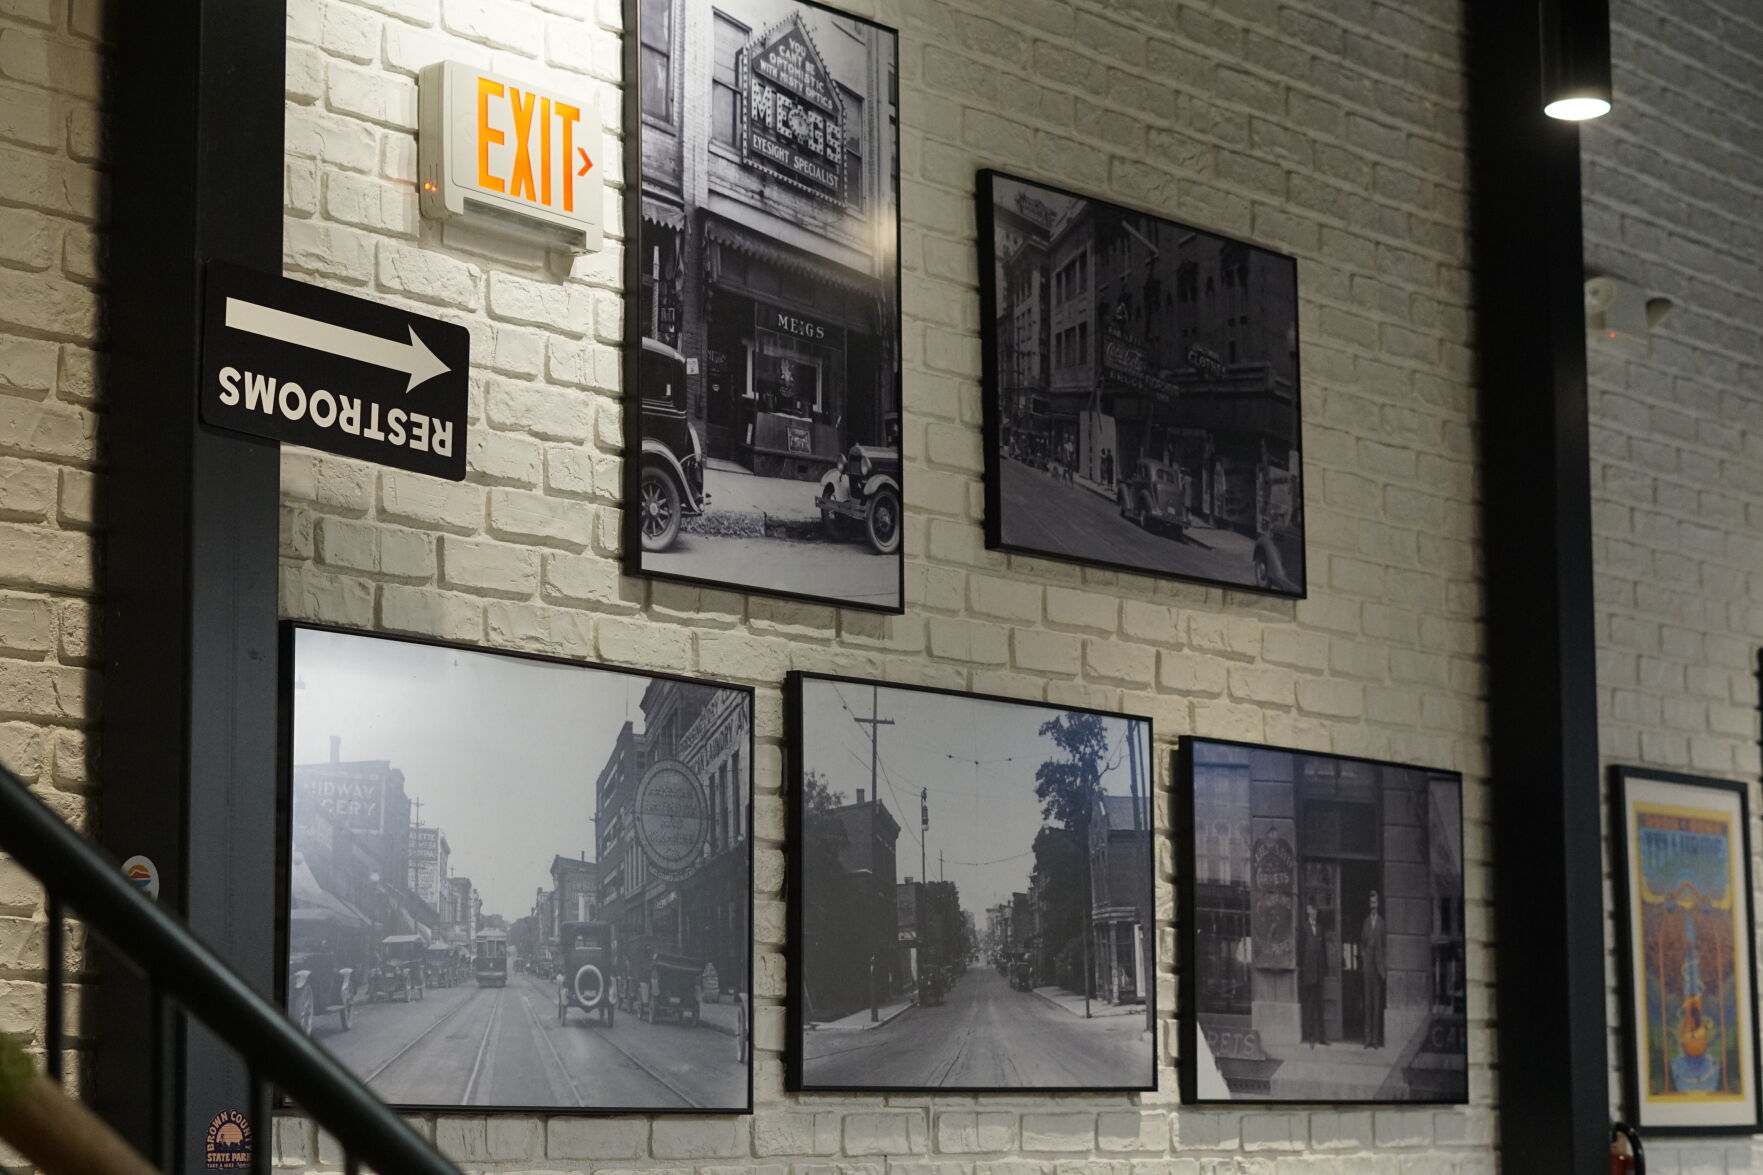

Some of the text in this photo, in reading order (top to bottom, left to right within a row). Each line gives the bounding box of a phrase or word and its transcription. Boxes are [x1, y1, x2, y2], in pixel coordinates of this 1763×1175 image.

[788, 37, 806, 58] YOU
[805, 60, 816, 75] BE
[759, 59, 833, 110] WITH MISTY OPTICS
[478, 77, 580, 213] EXIT
[752, 133, 839, 190] EYESIGHT SPECIALIST
[778, 313, 825, 339] MEIGS
[219, 366, 453, 457] RESTROOMS
[207, 1111, 228, 1151] BROWN
[207, 1152, 230, 1162] STATE
